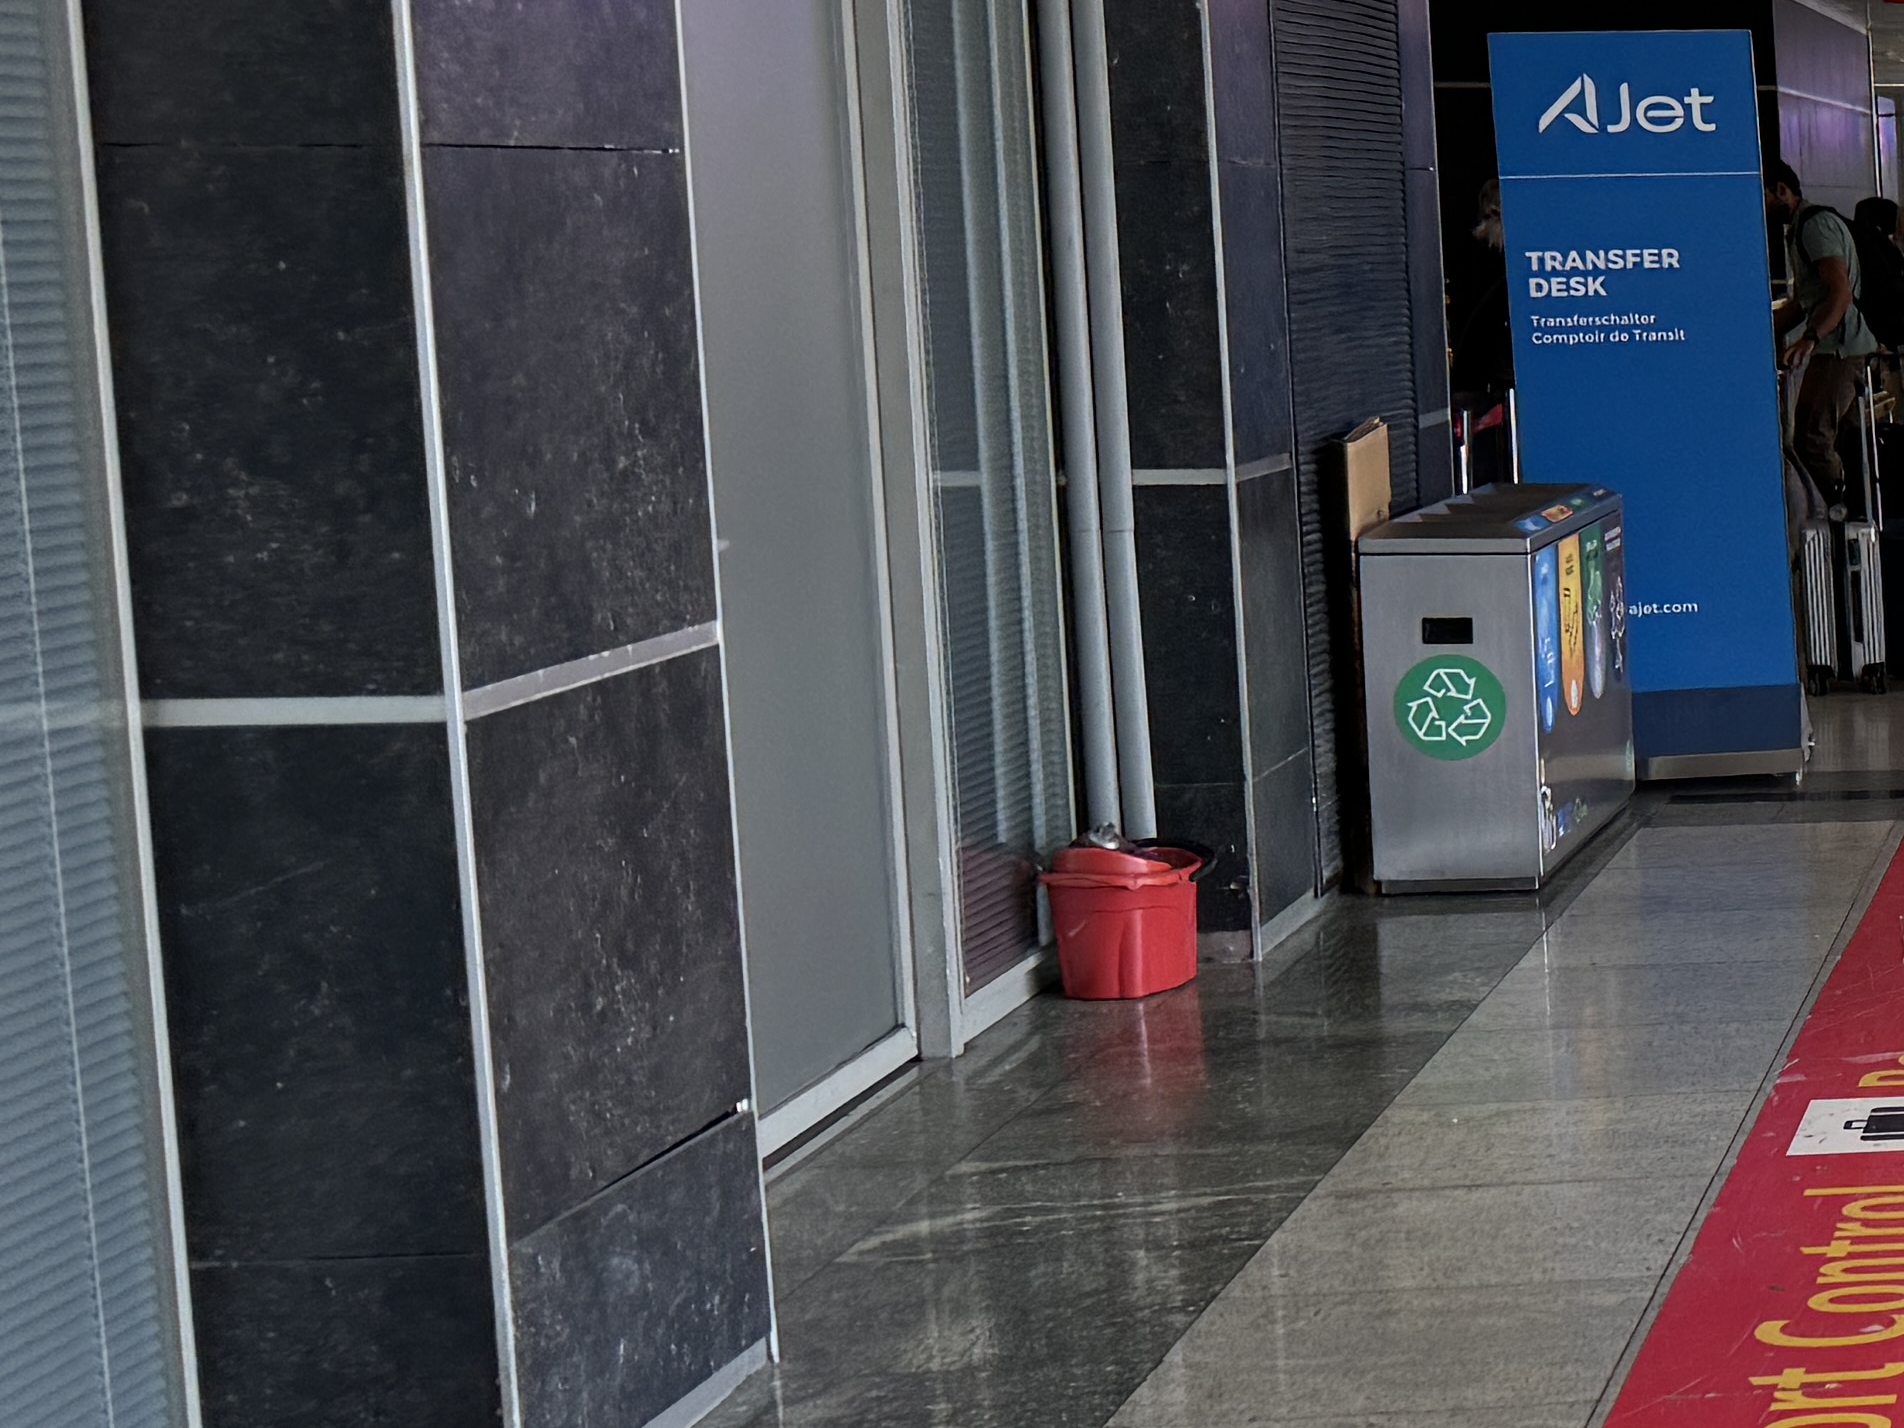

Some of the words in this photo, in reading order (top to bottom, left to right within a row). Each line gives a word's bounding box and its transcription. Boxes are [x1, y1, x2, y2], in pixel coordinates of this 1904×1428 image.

[1538, 72, 1717, 134] AJet
[1525, 248, 1681, 272] TRANSFER
[1528, 275, 1608, 299] DESK
[1532, 329, 1606, 346] Comptoir
[1633, 328, 1686, 343] Transit
